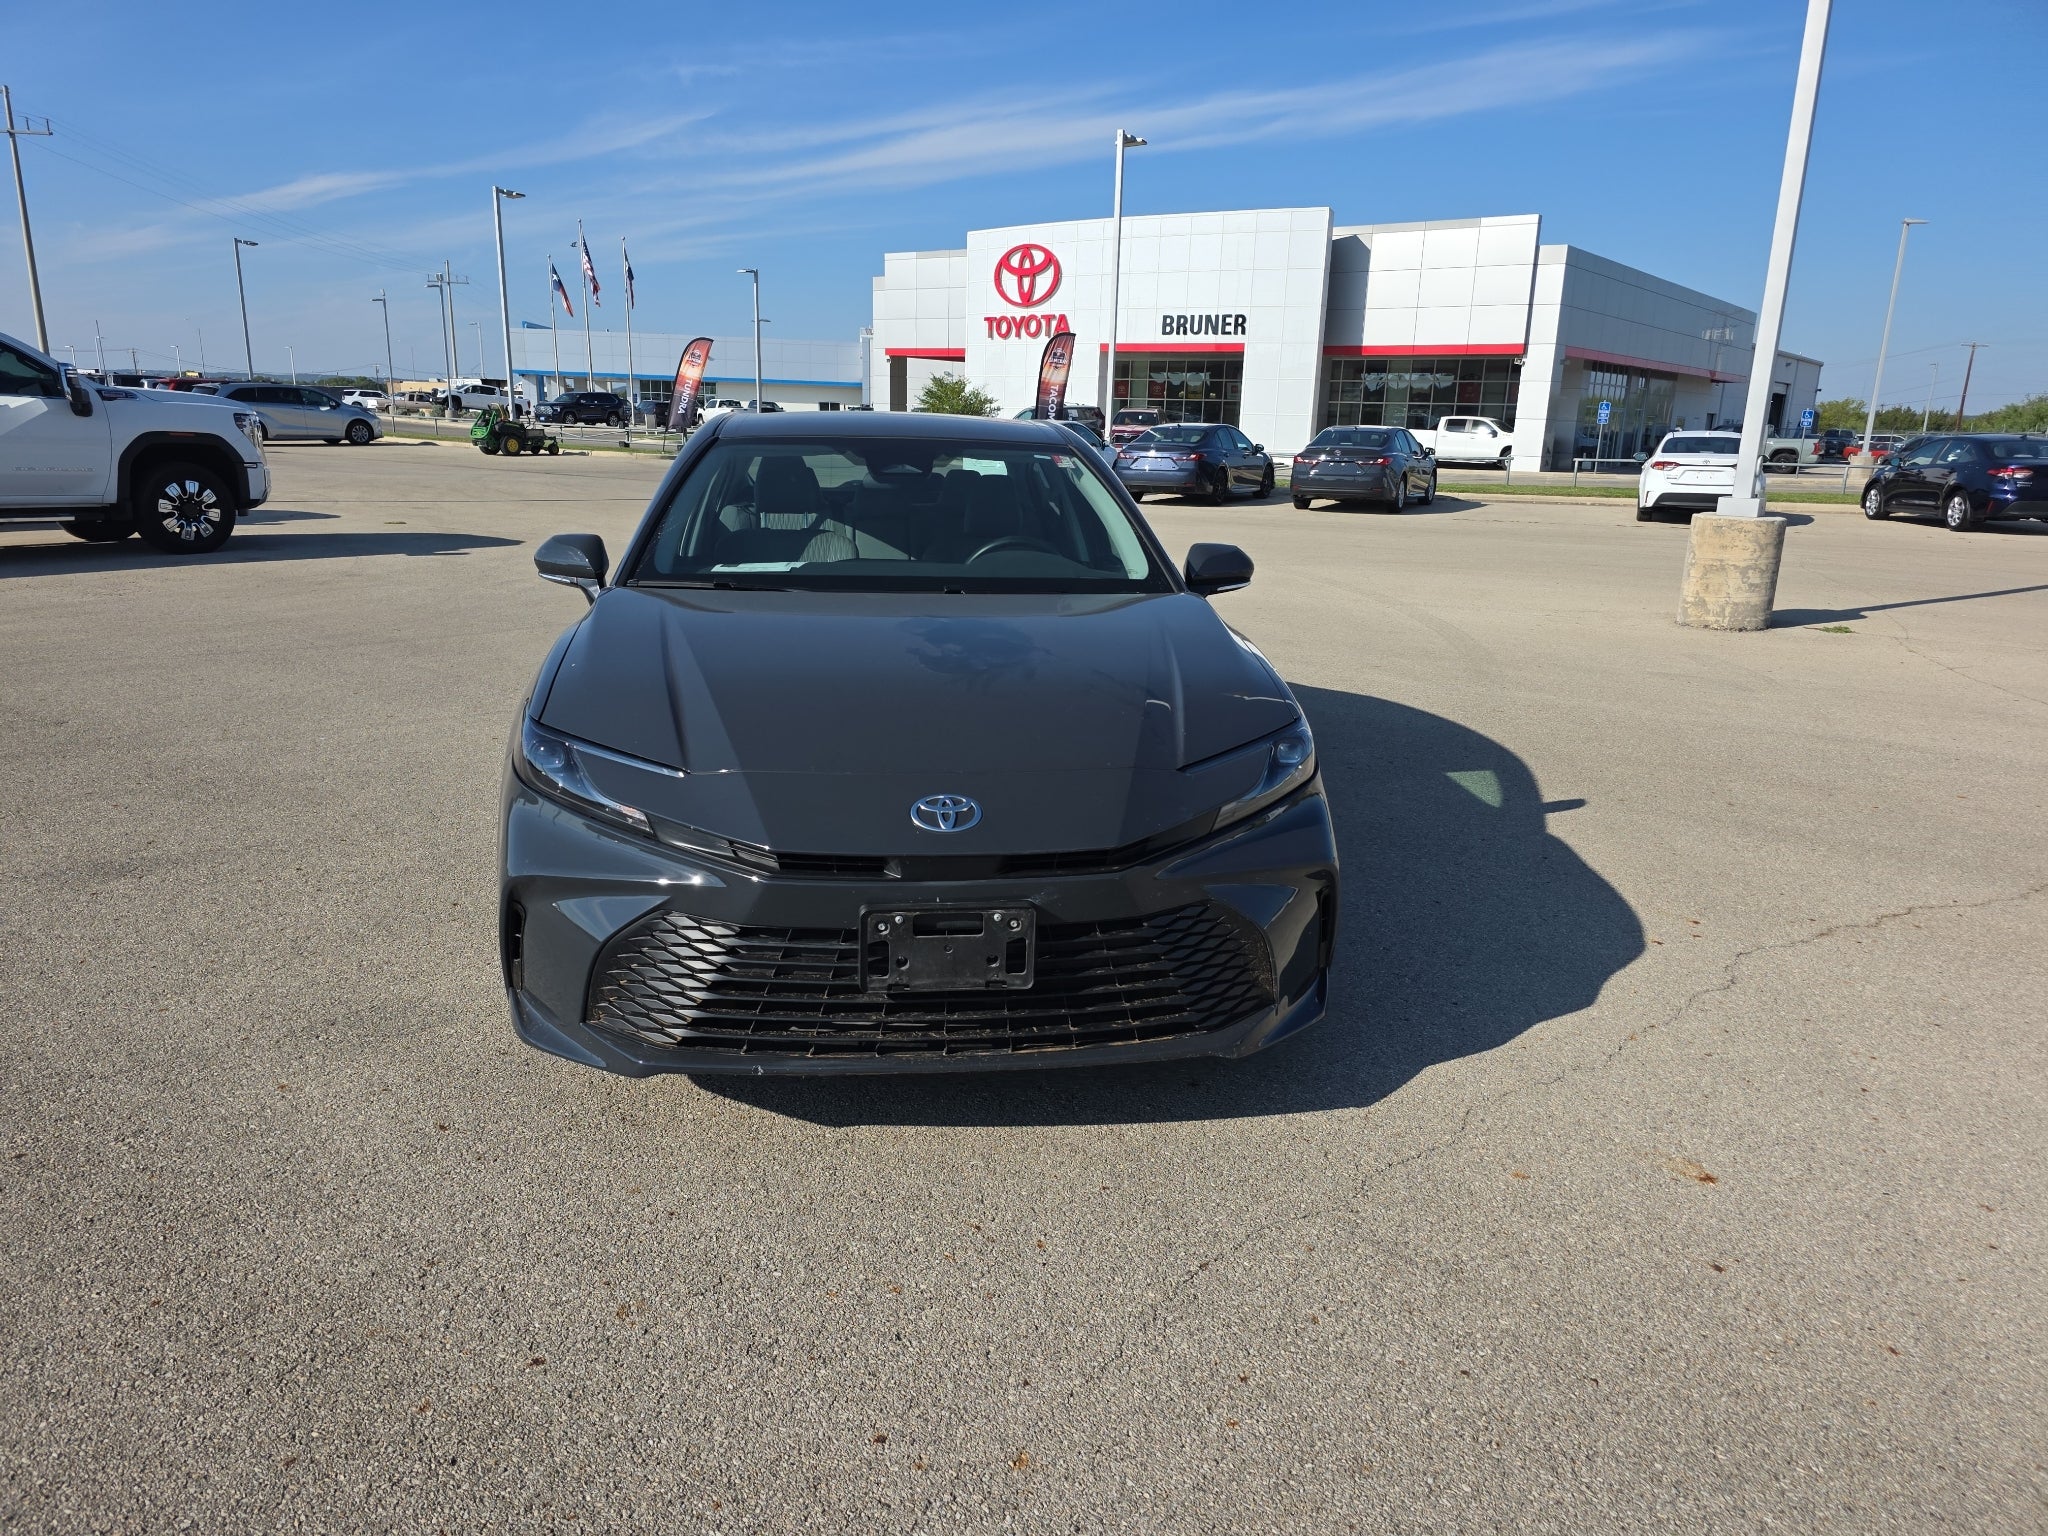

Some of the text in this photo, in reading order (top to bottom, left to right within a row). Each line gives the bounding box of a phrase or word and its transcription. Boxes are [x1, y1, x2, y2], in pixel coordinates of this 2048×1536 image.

[984, 314, 1070, 339] TOYOTA
[1161, 314, 1247, 336] BRUNER
[678, 380, 692, 414] TUNDRA
